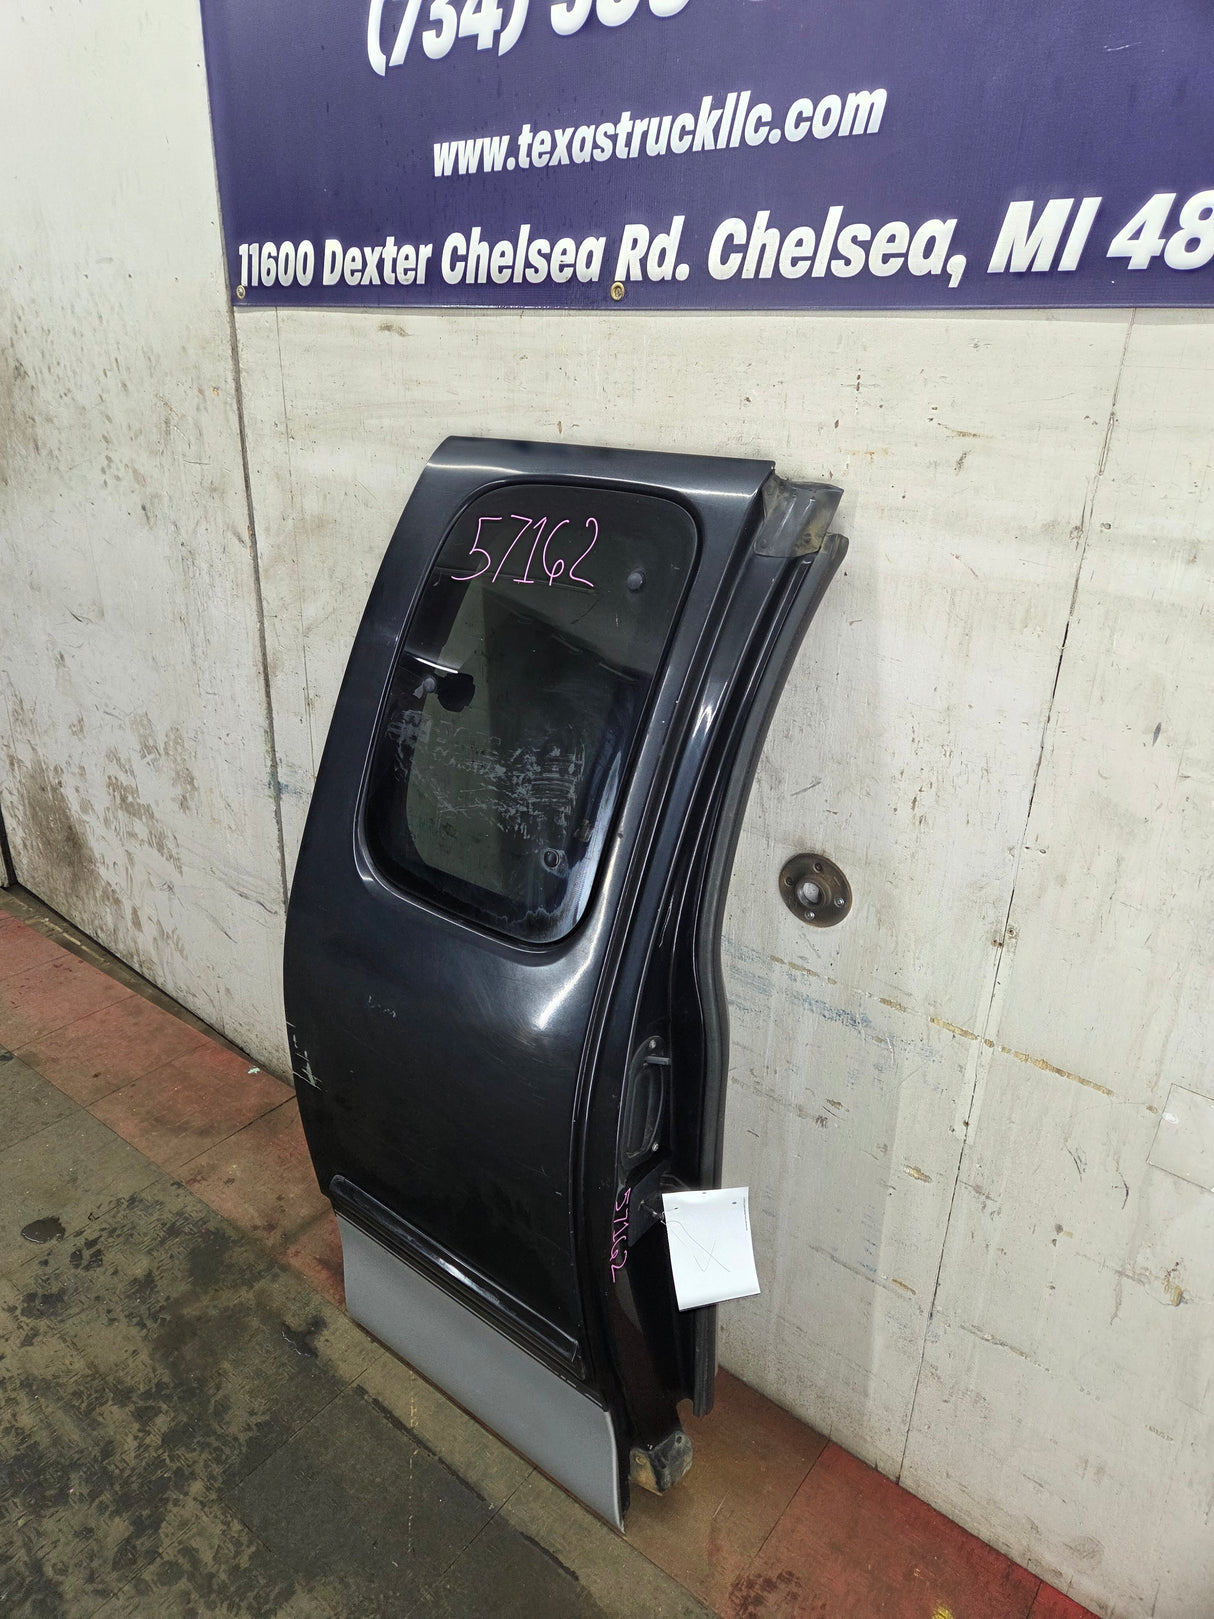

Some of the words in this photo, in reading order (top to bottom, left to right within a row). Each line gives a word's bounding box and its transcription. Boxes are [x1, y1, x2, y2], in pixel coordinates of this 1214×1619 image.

[433, 88, 888, 178] www.texastruckllc.com
[238, 240, 315, 287] 11600
[322, 236, 432, 286] Dexter
[441, 224, 606, 285] Chelsea
[615, 215, 690, 282] Rd.
[707, 205, 967, 289] Chelsea,
[987, 196, 1103, 274] MI
[450, 514, 598, 587] 57162
[609, 1187, 632, 1284] 57162
